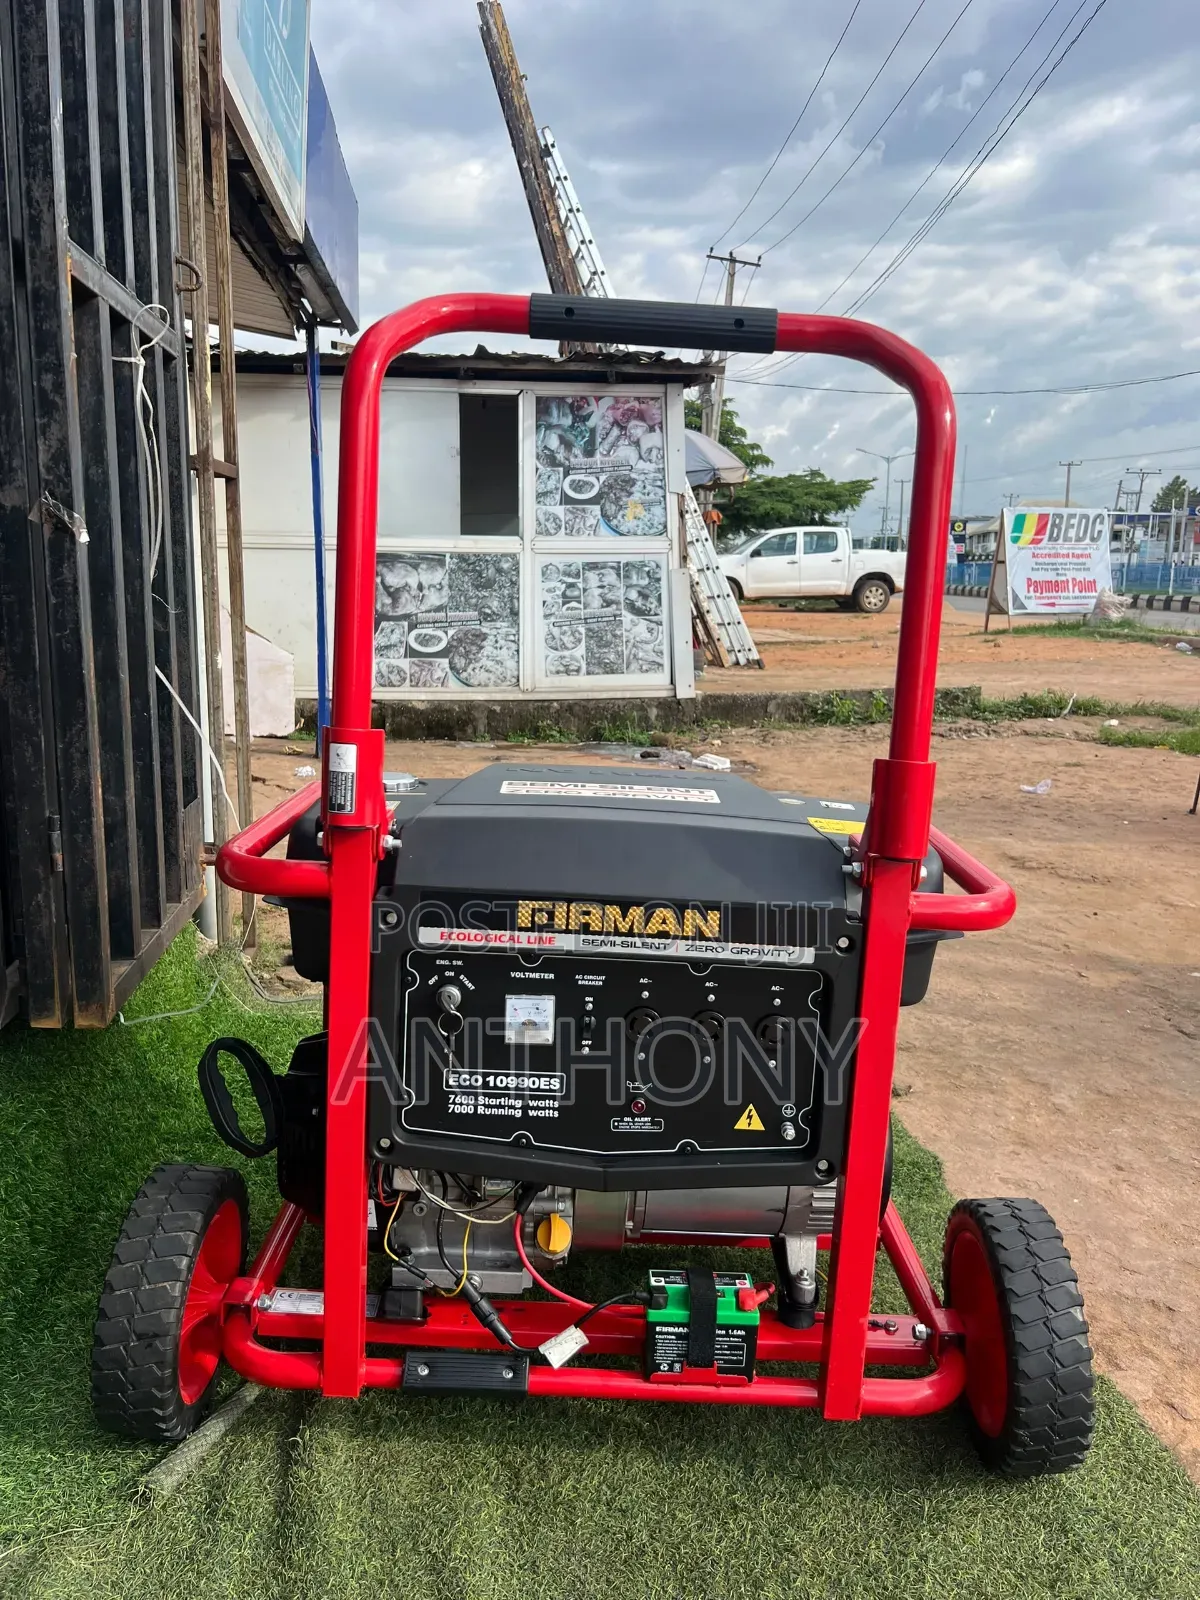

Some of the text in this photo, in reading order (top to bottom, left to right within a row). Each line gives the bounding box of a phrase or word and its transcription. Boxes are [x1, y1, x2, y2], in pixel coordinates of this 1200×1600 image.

[1047, 513, 1105, 543] BEDC
[1071, 552, 1092, 560] Agent
[1026, 577, 1098, 595] Payment Point
[507, 781, 713, 795] SEMI-SILENT
[593, 791, 715, 801] GRAVITY
[516, 899, 721, 938] FIRMAN
[440, 931, 795, 958] ECOLOGICAL LINE SEMI-SILENT ZERO GRAVITY
[428, 974, 439, 986] OFF
[459, 974, 476, 991] START
[510, 971, 555, 980] VOLTMETER
[448, 1073, 560, 1090] ECO 10990ES
[448, 1094, 559, 1108] 7600 Starting watts
[448, 1104, 559, 1118] 7000 Running watts
